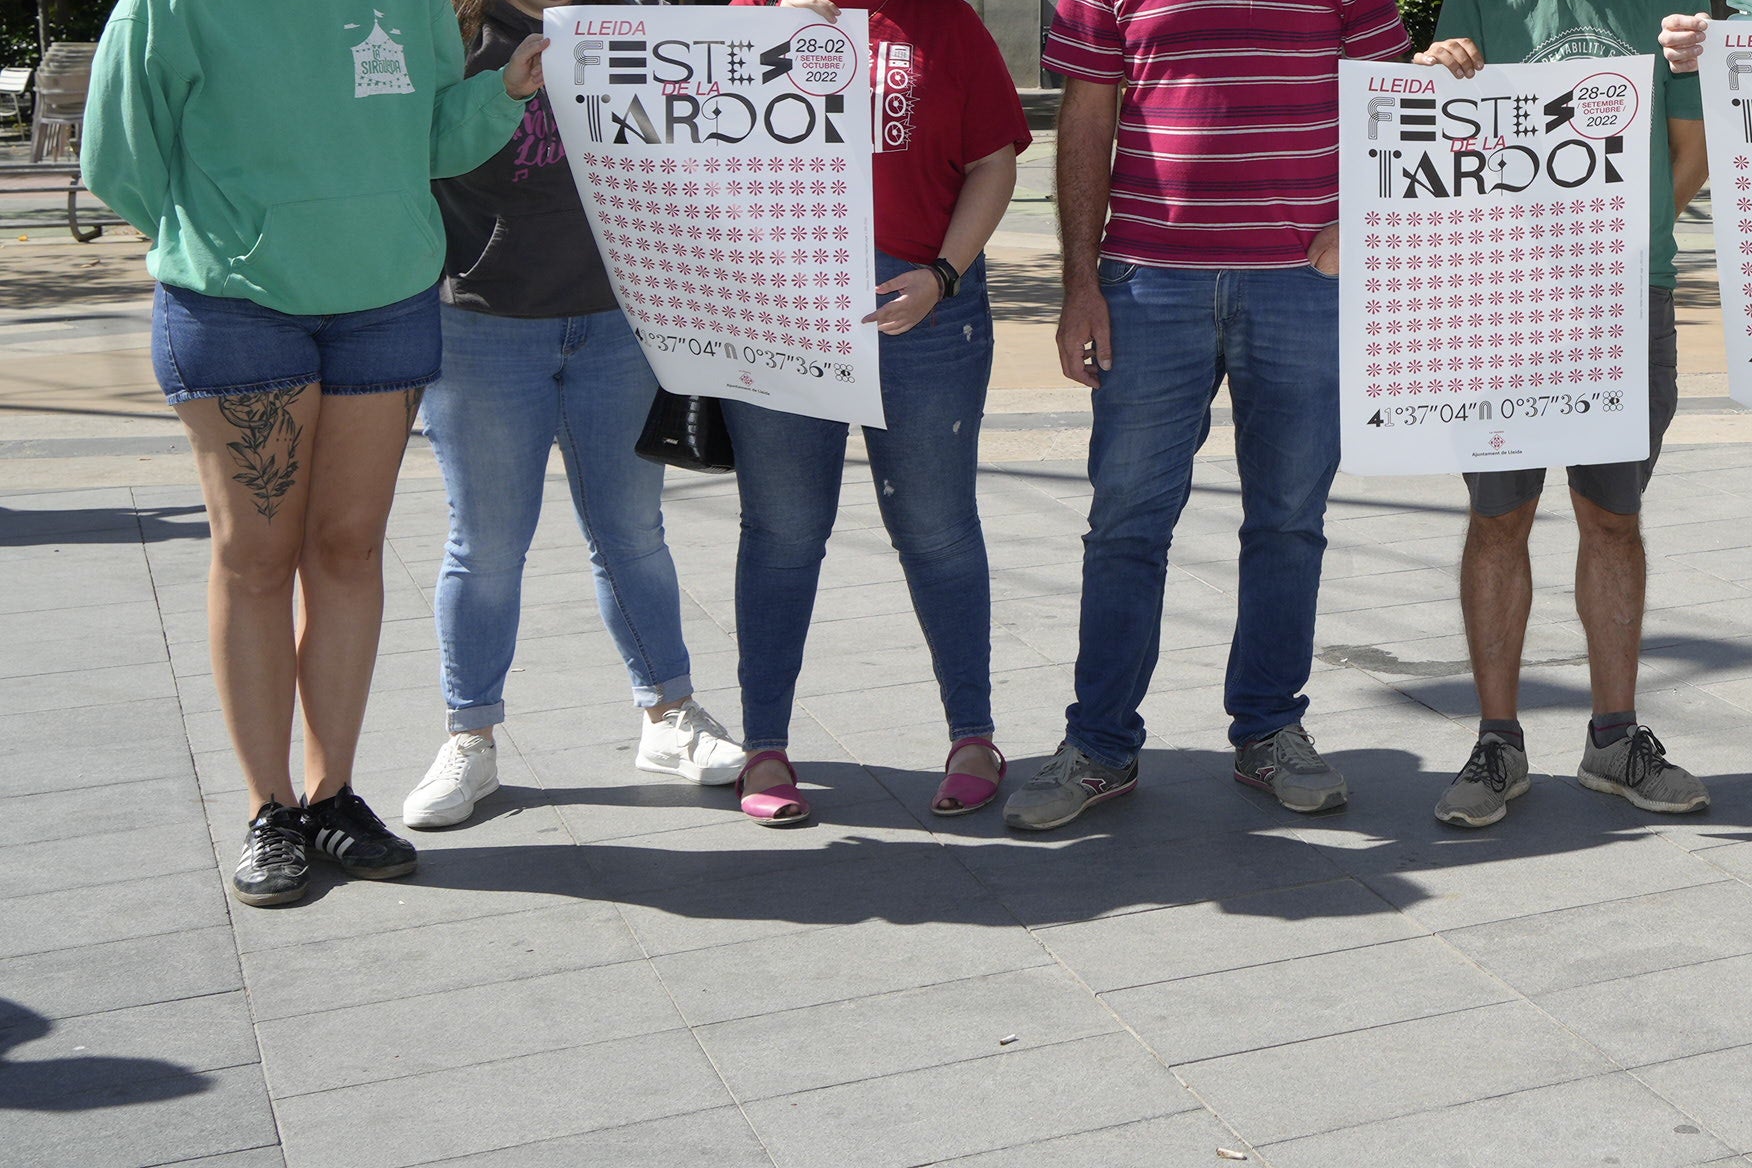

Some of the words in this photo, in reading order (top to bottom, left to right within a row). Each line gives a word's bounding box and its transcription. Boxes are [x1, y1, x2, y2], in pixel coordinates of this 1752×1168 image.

[574, 21, 646, 35] LLEIDA
[795, 38, 845, 53] 28-02
[573, 40, 793, 85] FESTES
[805, 71, 837, 82] 2022
[661, 81, 690, 96] DE
[696, 81, 721, 96] LA
[1368, 77, 1436, 94] LLEIDA
[1578, 84, 1627, 100] 28-02
[1582, 99, 1624, 109] SETEMBRE
[1583, 106, 1621, 115] OCTUBRE
[1367, 89, 1575, 141] FESTES
[1587, 115, 1618, 127] 2022
[1450, 137, 1477, 153] DE
[1482, 135, 1507, 151] LA
